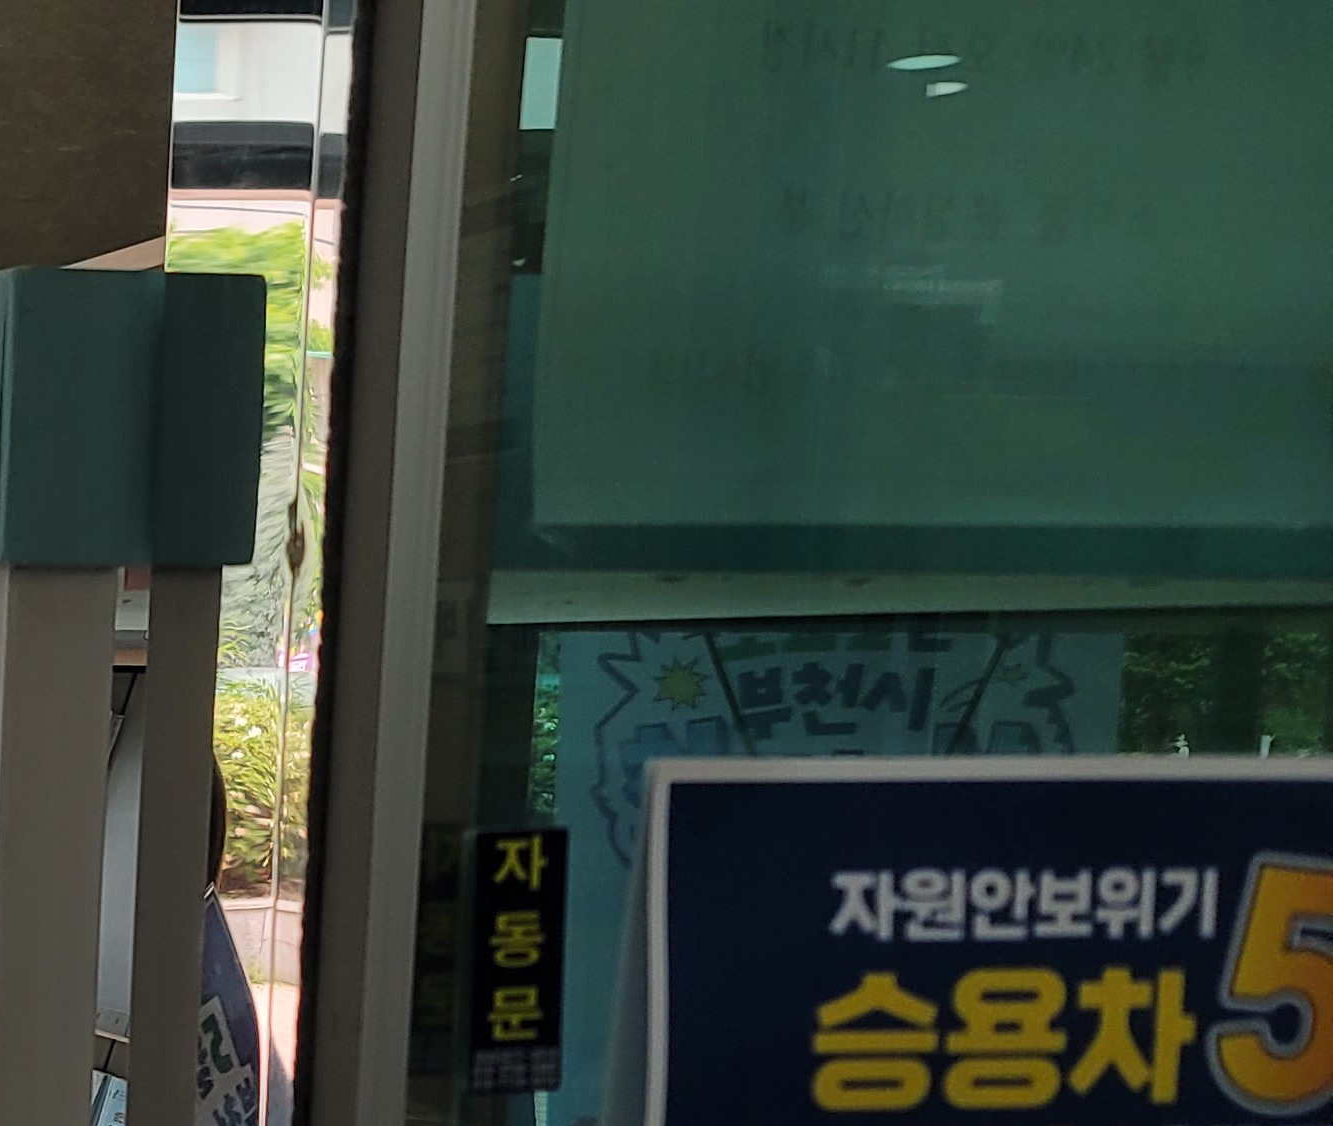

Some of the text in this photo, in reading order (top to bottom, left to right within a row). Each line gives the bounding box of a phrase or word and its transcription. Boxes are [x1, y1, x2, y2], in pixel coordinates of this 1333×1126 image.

[736, 662, 937, 739] 부천시
[488, 836, 549, 1046] 자동문
[828, 866, 1220, 943] 자원안보위기
[809, 965, 1196, 1113] 승용차
